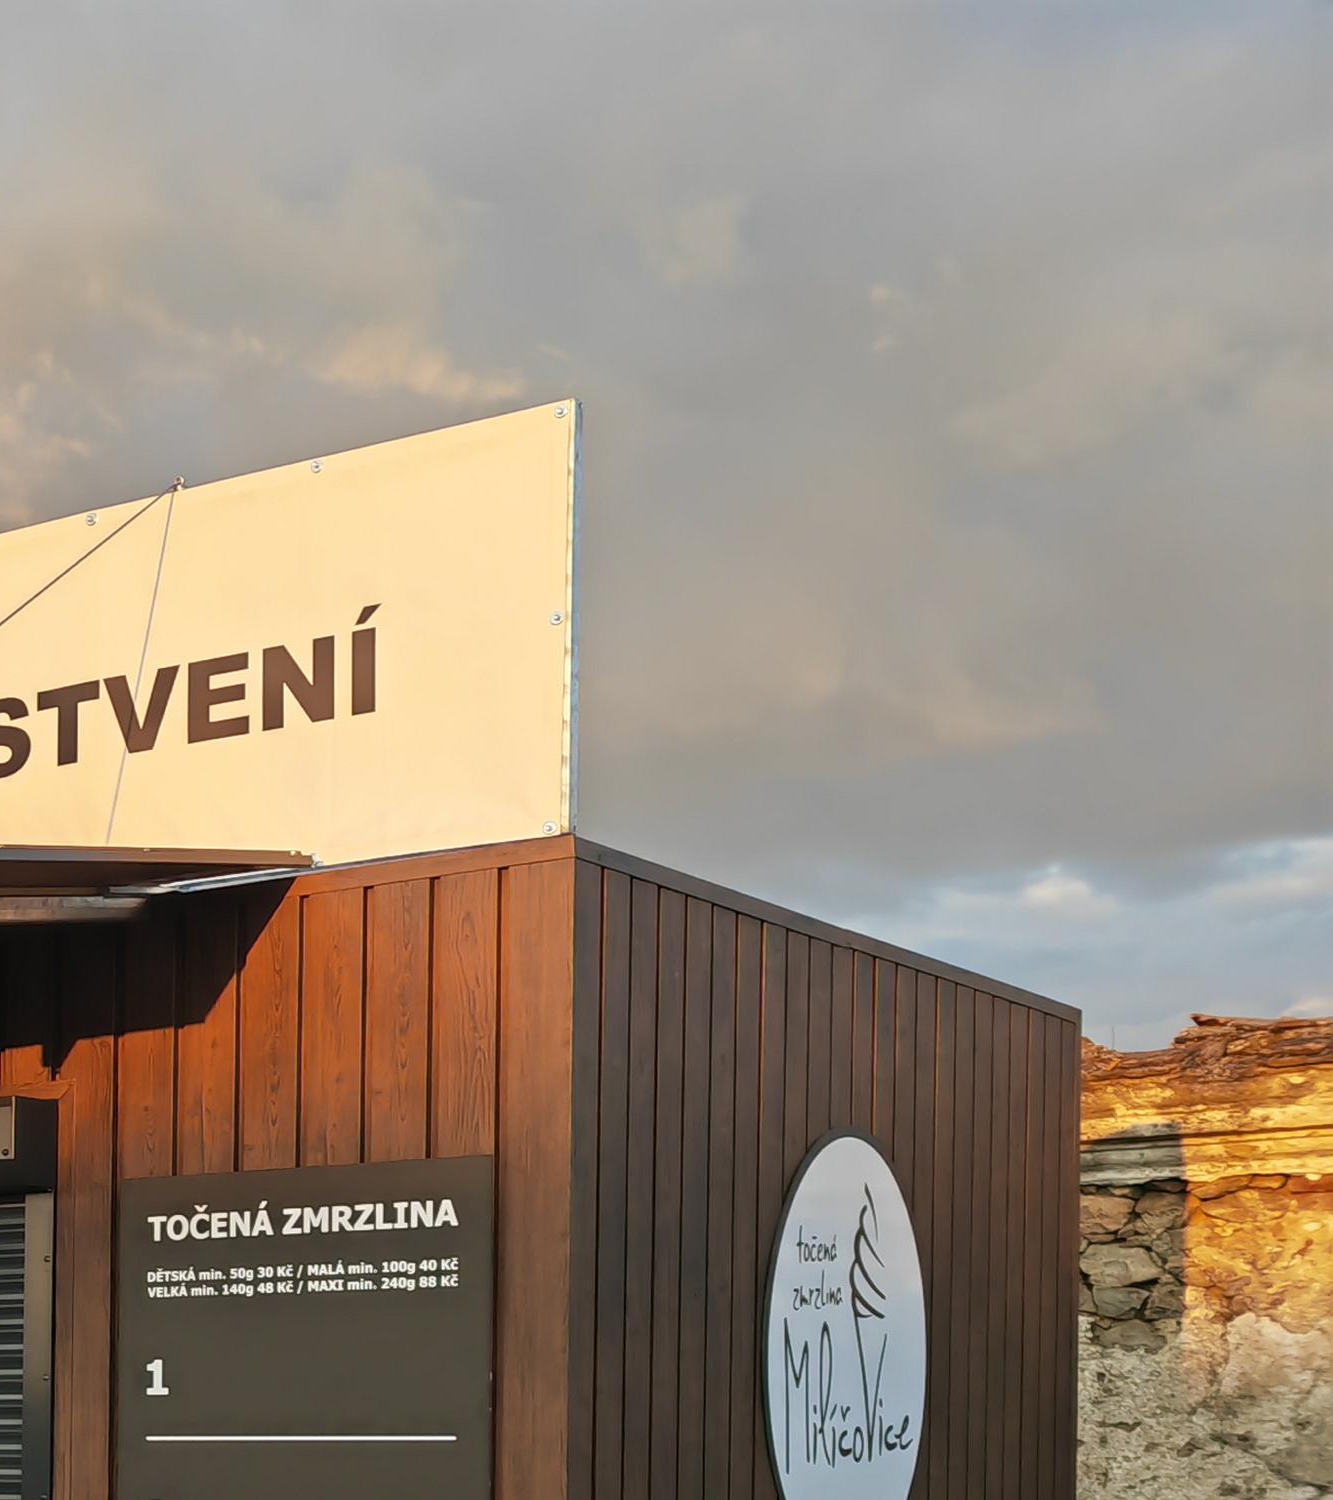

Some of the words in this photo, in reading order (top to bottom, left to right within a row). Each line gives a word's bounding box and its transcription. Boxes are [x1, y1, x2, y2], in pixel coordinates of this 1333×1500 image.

[147, 1200, 274, 1241] TOČENÁ
[282, 1199, 459, 1235] ZMRZLINA
[796, 1225, 837, 1264] točená
[147, 1267, 195, 1282] DĚTSKÁ
[199, 1269, 226, 1280] min.
[229, 1267, 254, 1281] 50g
[257, 1266, 273, 1278] 30
[277, 1264, 293, 1277] Kč
[307, 1260, 345, 1276] MALÁ
[348, 1262, 377, 1274] min.
[382, 1261, 415, 1274] 100g
[419, 1260, 437, 1271] 40
[441, 1258, 458, 1270] Kč
[148, 1283, 187, 1298] VELKÁ
[191, 1285, 218, 1296] min.
[222, 1284, 254, 1297] 140g
[257, 1283, 274, 1293] 48
[277, 1280, 294, 1293] Kč
[307, 1280, 344, 1292] MAXI
[347, 1279, 377, 1291] min.
[381, 1277, 415, 1291] 240g
[419, 1276, 437, 1288] 88
[441, 1274, 458, 1287] Kč
[145, 1359, 169, 1396] 1
